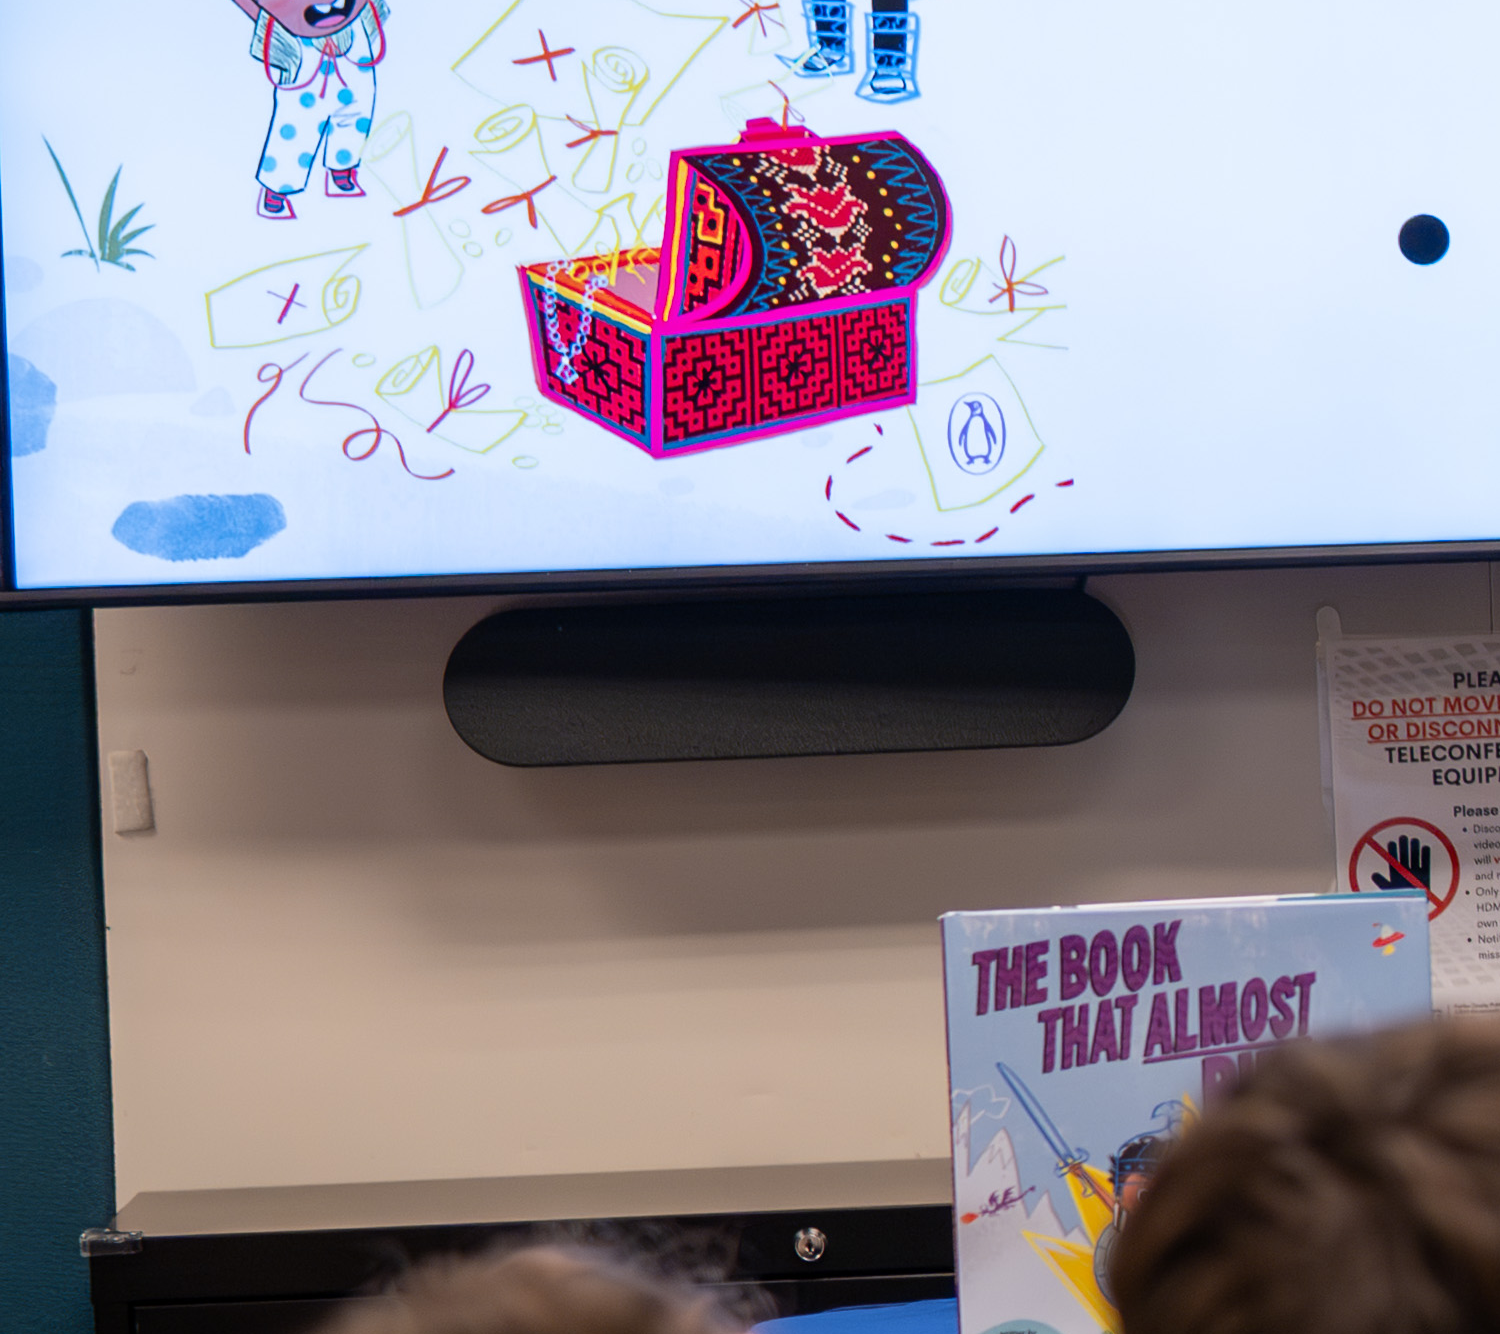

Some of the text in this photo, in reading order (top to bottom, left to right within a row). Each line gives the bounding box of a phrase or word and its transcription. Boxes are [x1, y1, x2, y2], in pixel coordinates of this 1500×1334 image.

[1352, 701, 1385, 718] DO
[1391, 698, 1438, 717] NOT
[1368, 723, 1400, 742] OR
[1453, 805, 1499, 818] Please
[1473, 854, 1492, 865] will
[1475, 869, 1494, 881] and
[1475, 886, 1499, 899] Only
[1476, 920, 1498, 929] own
[971, 919, 1184, 1017] THE BOOK
[1038, 972, 1317, 1075] THAT ALMOST
